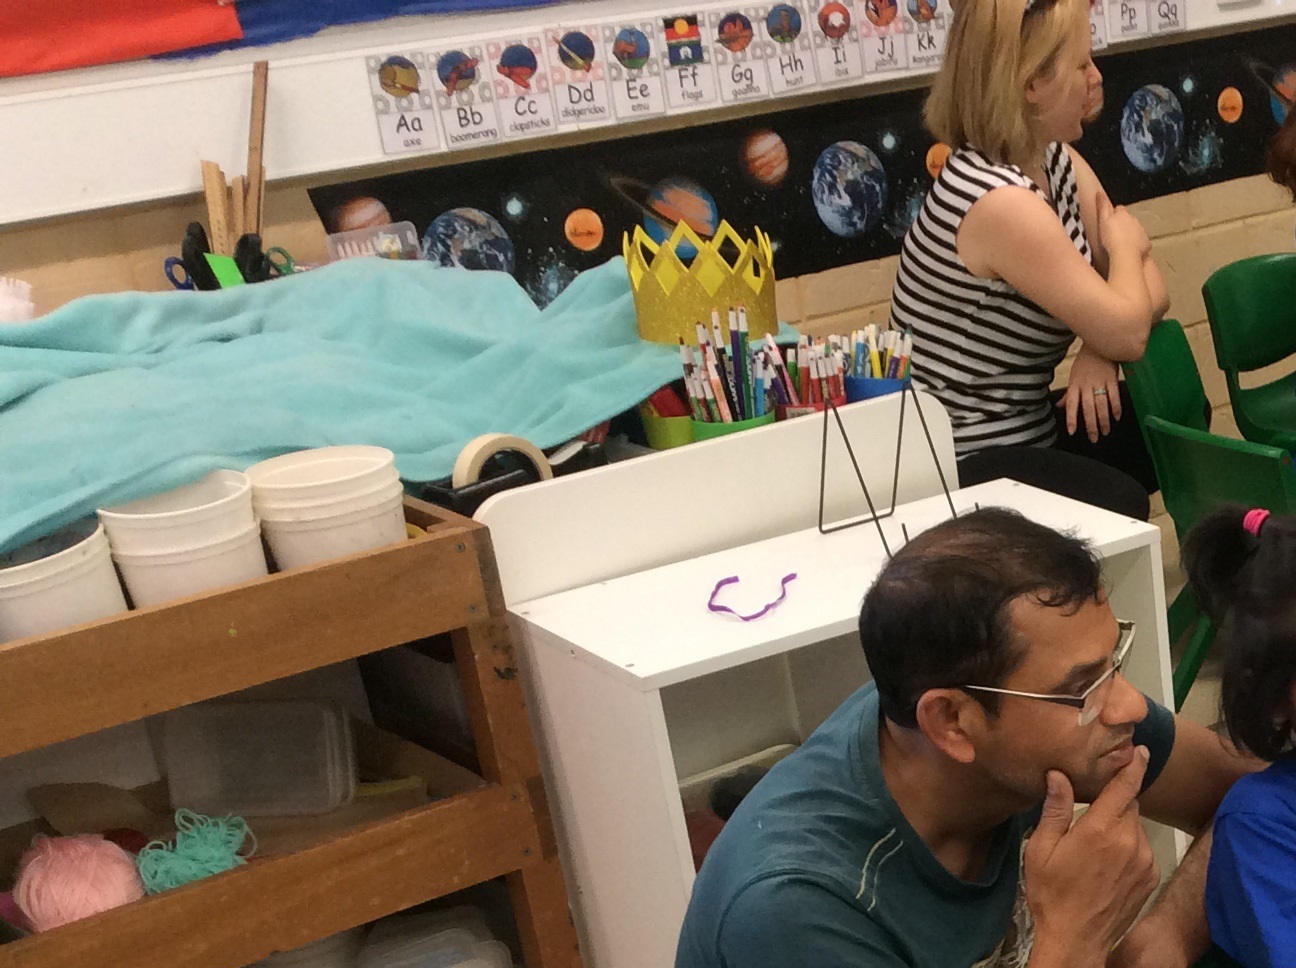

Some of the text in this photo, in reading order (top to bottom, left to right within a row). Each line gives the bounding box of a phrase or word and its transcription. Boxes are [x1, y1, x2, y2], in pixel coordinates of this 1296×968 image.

[1120, 3, 1136, 25] Pp
[1157, 1, 1178, 21] Qq
[877, 35, 895, 57] Jj
[916, 30, 937, 52] Kk
[779, 53, 804, 75] Hh
[832, 45, 847, 65] Ii
[678, 67, 700, 88] Ff
[731, 64, 754, 86] Gg
[567, 82, 595, 104] Dd
[625, 79, 651, 100] Ee
[457, 106, 484, 128] Bb
[514, 96, 539, 117] Cc
[631, 103, 650, 112] emu
[396, 113, 424, 134] Aa
[403, 138, 422, 148] axe
[449, 126, 498, 144] boomerang
